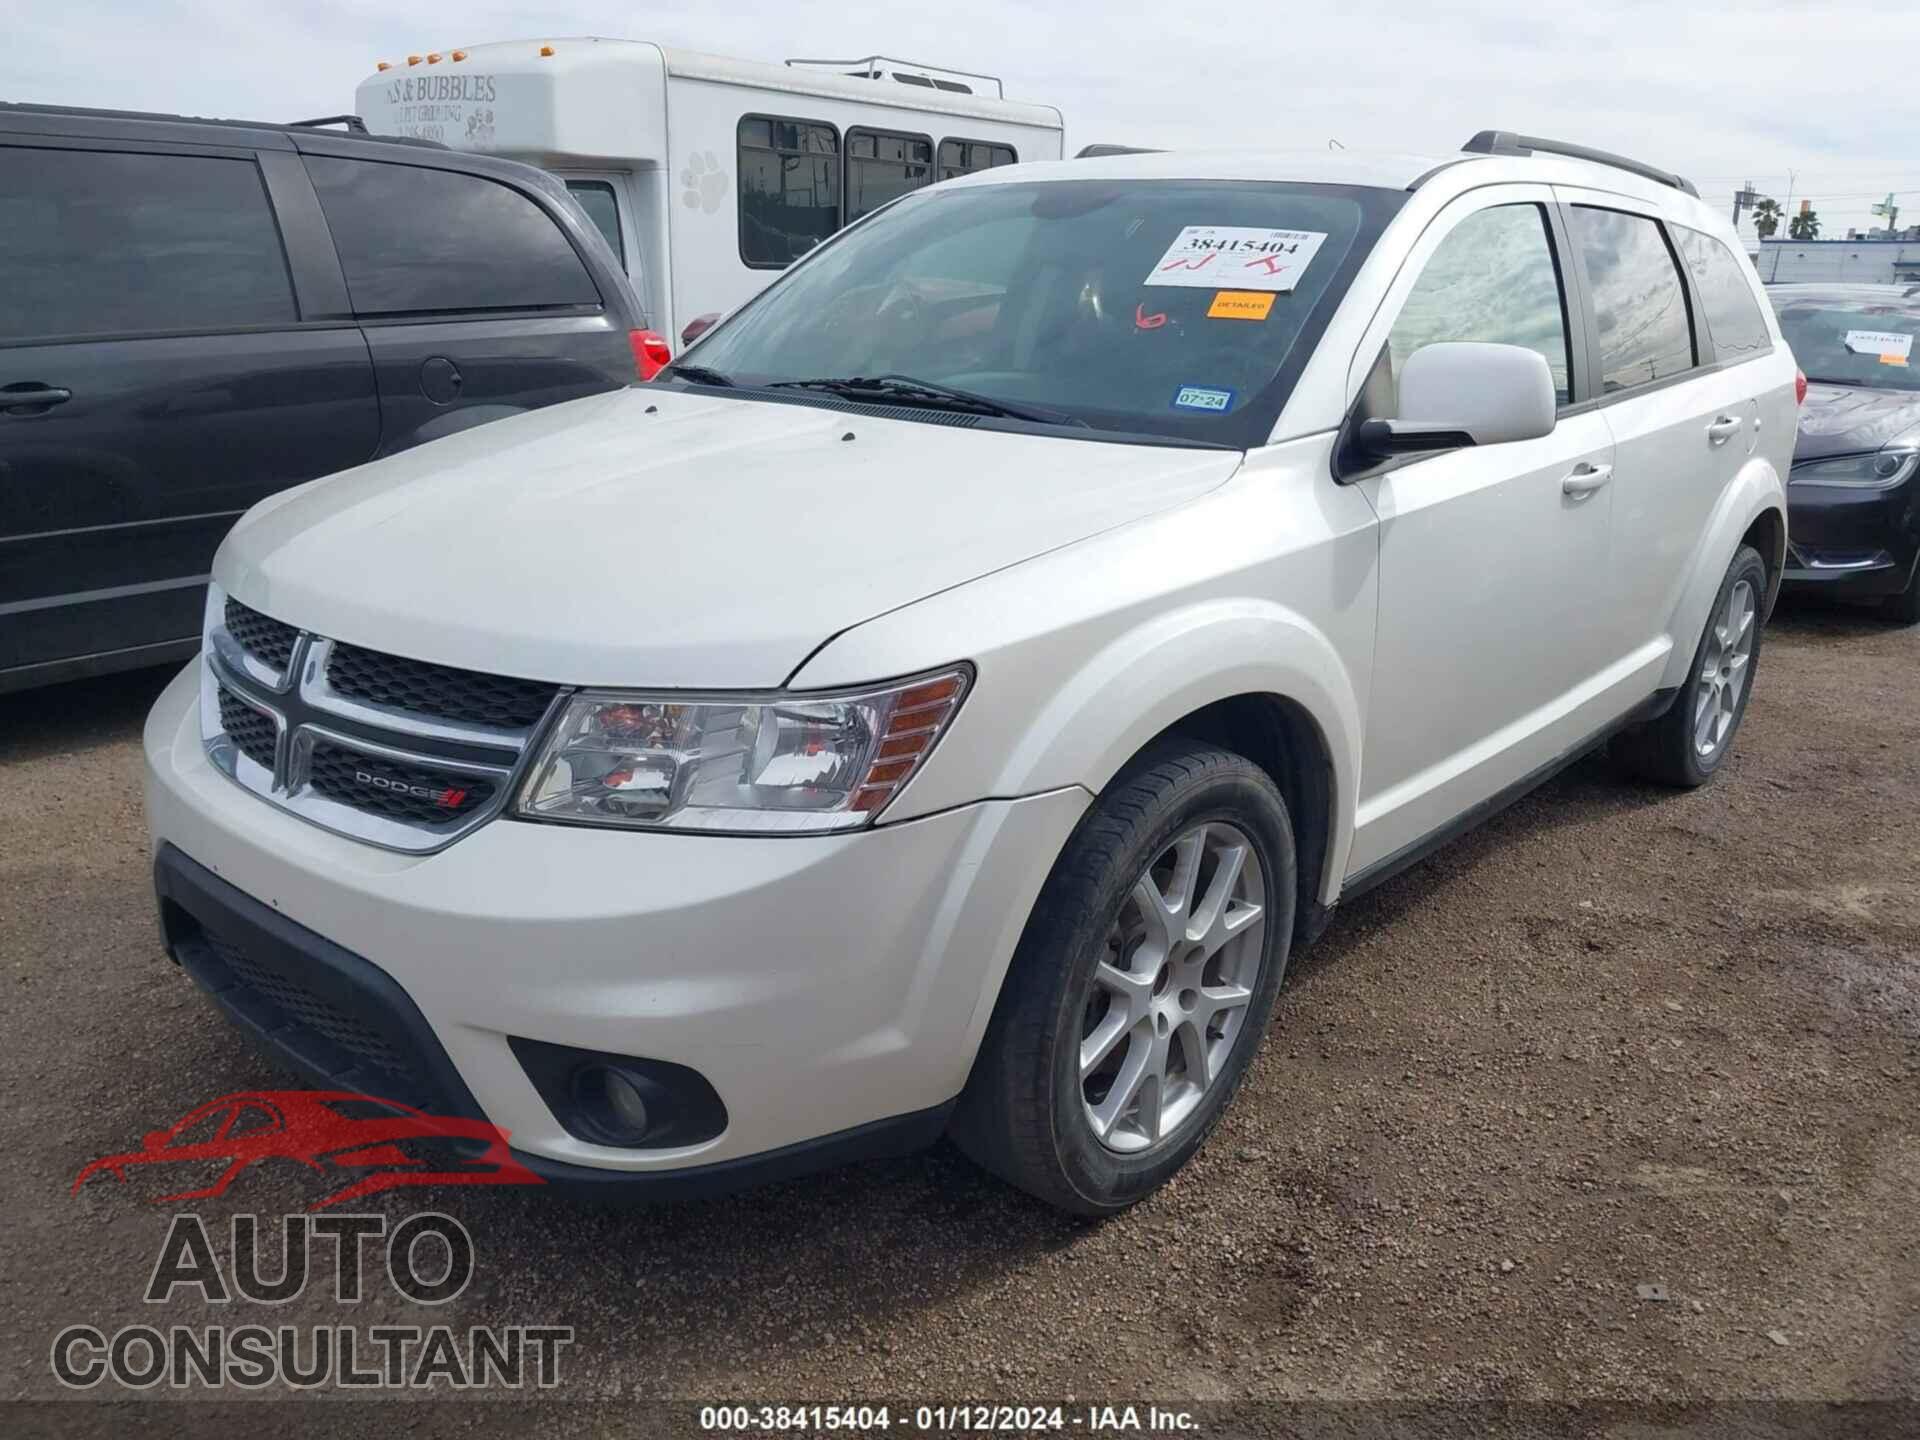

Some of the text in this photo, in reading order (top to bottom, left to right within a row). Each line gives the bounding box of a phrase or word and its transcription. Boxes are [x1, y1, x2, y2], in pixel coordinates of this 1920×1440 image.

[402, 78, 414, 103] &
[416, 74, 496, 104] BUBBLES
[1183, 237, 1300, 255] 38415404
[356, 771, 450, 802] DODGE
